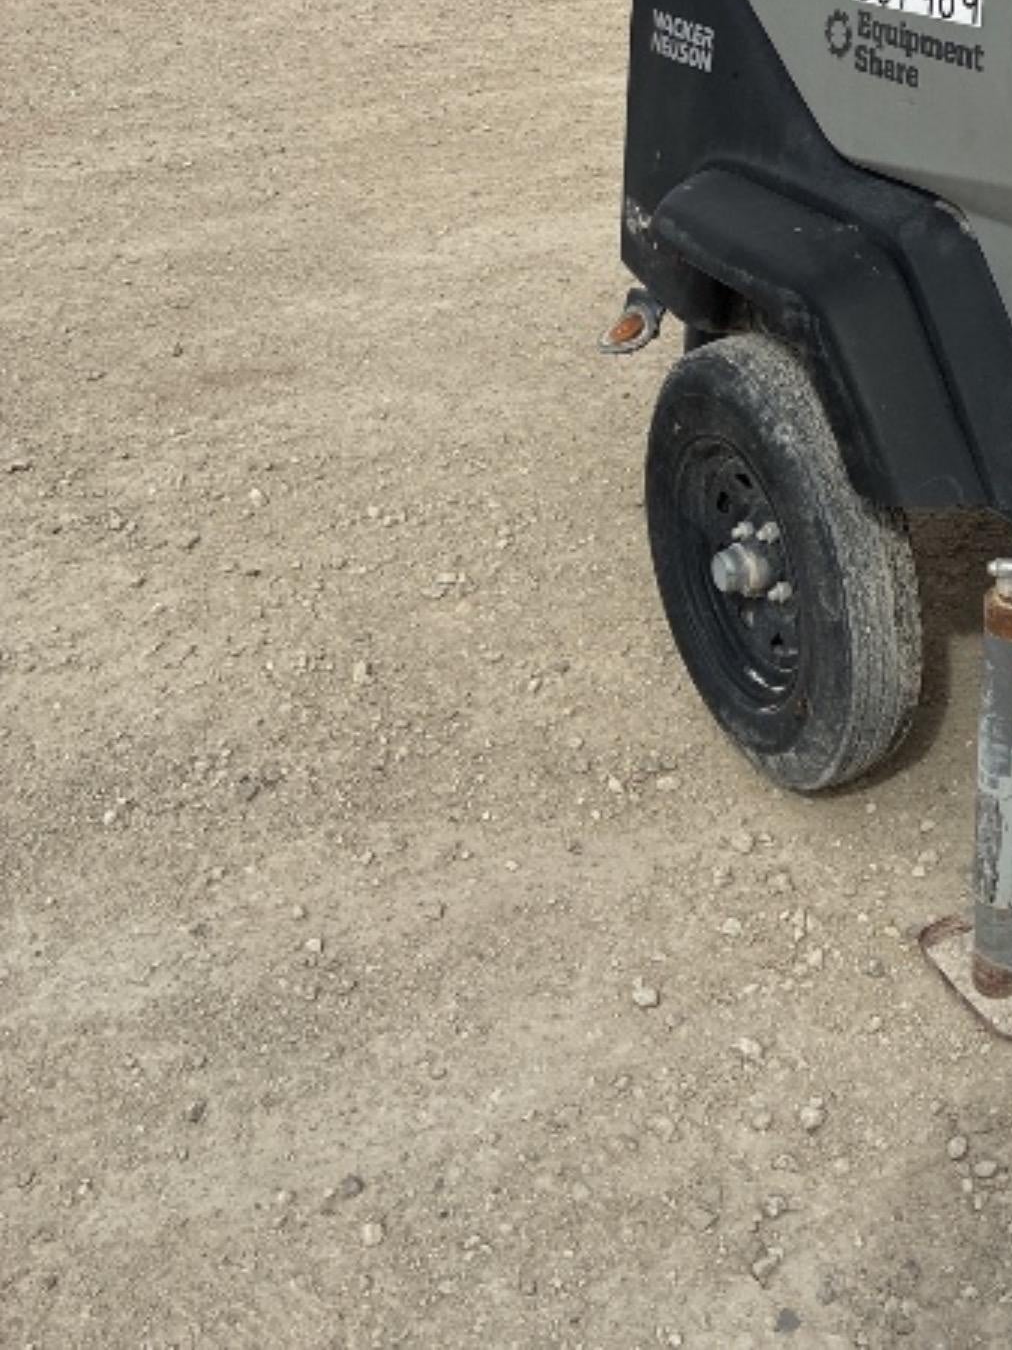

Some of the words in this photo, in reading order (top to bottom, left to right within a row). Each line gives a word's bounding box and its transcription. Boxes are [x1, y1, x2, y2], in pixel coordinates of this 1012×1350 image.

[652, 8, 716, 49] WACKER
[857, 9, 985, 72] Equipment
[650, 31, 713, 73] NEUSON
[854, 44, 919, 88] Share
